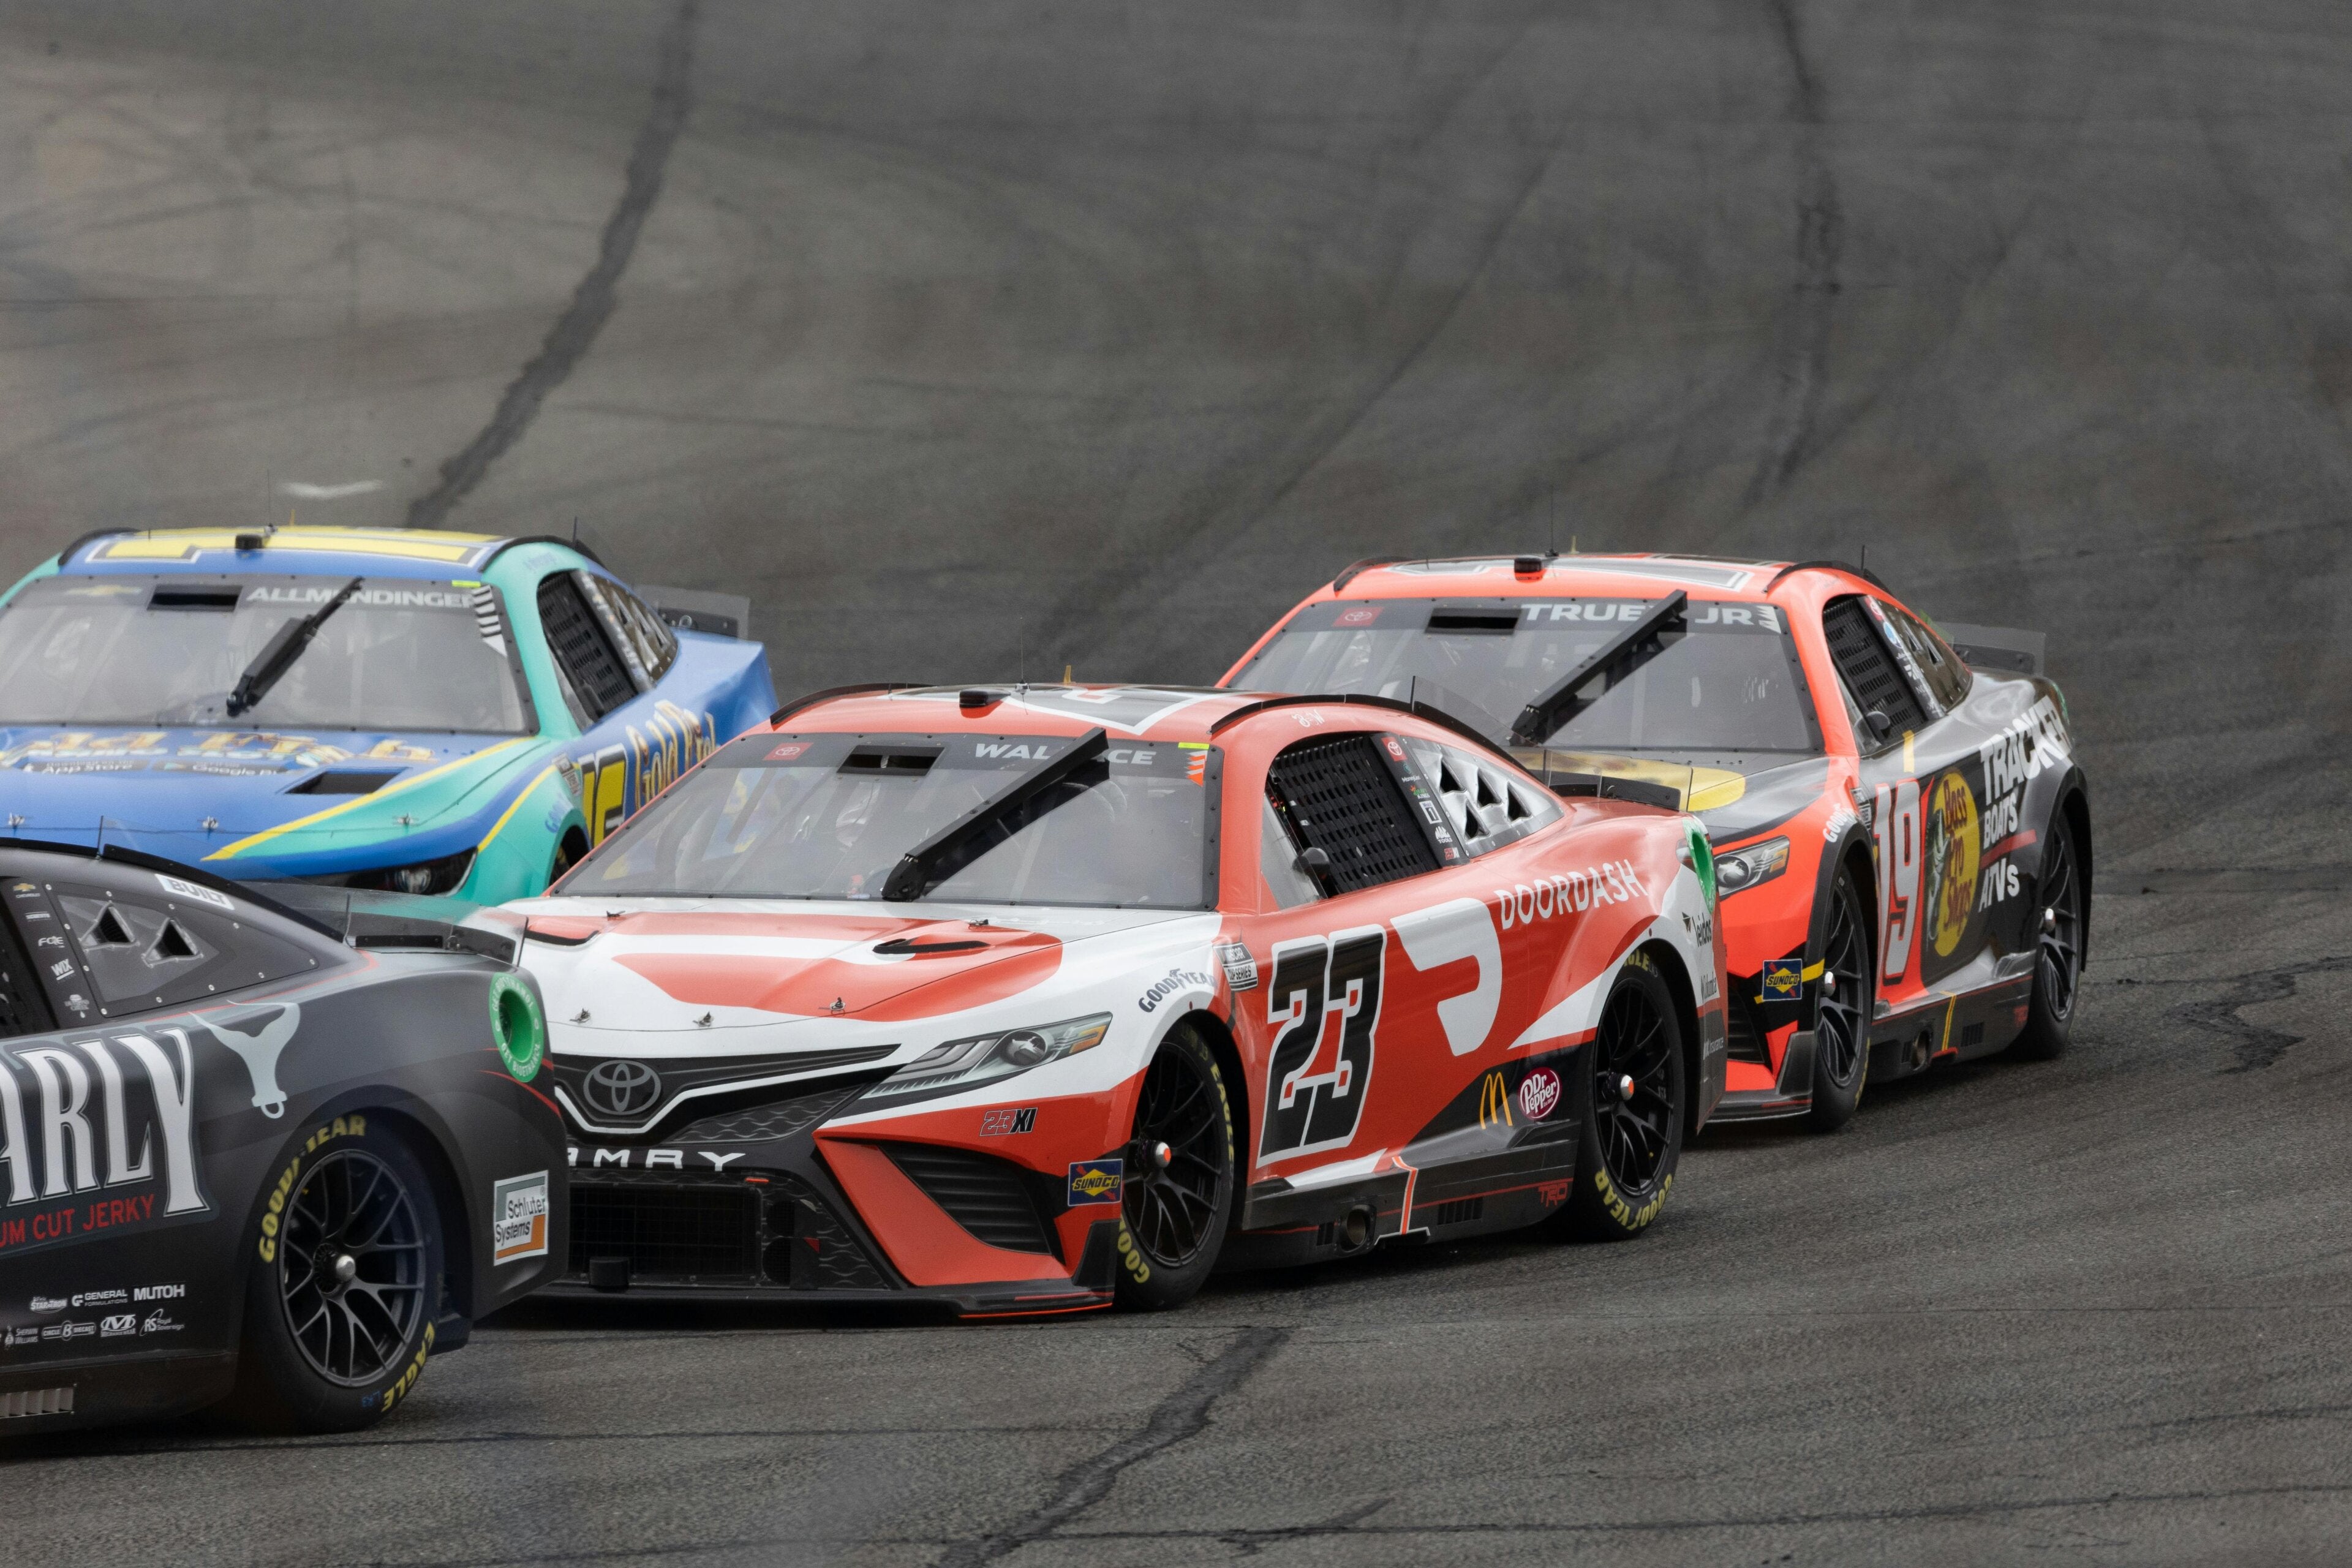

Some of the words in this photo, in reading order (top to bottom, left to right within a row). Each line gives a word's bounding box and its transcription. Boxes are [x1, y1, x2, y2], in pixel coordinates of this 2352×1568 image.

[246, 586, 475, 608] ALLMNDINGER
[1695, 608, 1754, 625] JR
[975, 743, 1157, 766] WALCE
[1980, 695, 2073, 805] TRACKER
[1943, 779, 1968, 833] Bass
[1983, 793, 2018, 850] BOATS
[167, 878, 227, 905] BUILT
[1873, 778, 1920, 986] 19
[1493, 859, 1649, 930] DOORDASH
[1692, 912, 1713, 948] leidos
[51, 958, 74, 976] WIX
[1235, 965, 1252, 980] SERIES
[1767, 974, 1799, 986] SUNOCO
[1257, 924, 1387, 1169] 23
[1532, 1073, 1547, 1094] Dr
[1520, 1079, 1557, 1115] Pepper
[979, 1107, 1038, 1137] 23XI
[1210, 1065, 1235, 1163] EAGLE
[1074, 1175, 1120, 1190] SUNOCO
[1538, 1183, 1569, 1207] TRD
[32, 1208, 75, 1240] CUT
[83, 1193, 155, 1231] JERKY
[507, 1196, 546, 1219] Schluter
[496, 1221, 531, 1246] Systems
[85, 1289, 128, 1301] GENERAL
[85, 1298, 128, 1307] FORMULATIONS
[134, 1284, 186, 1302] MUTOH
[144, 1317, 157, 1333] RS
[381, 1321, 436, 1413] EAGLE
